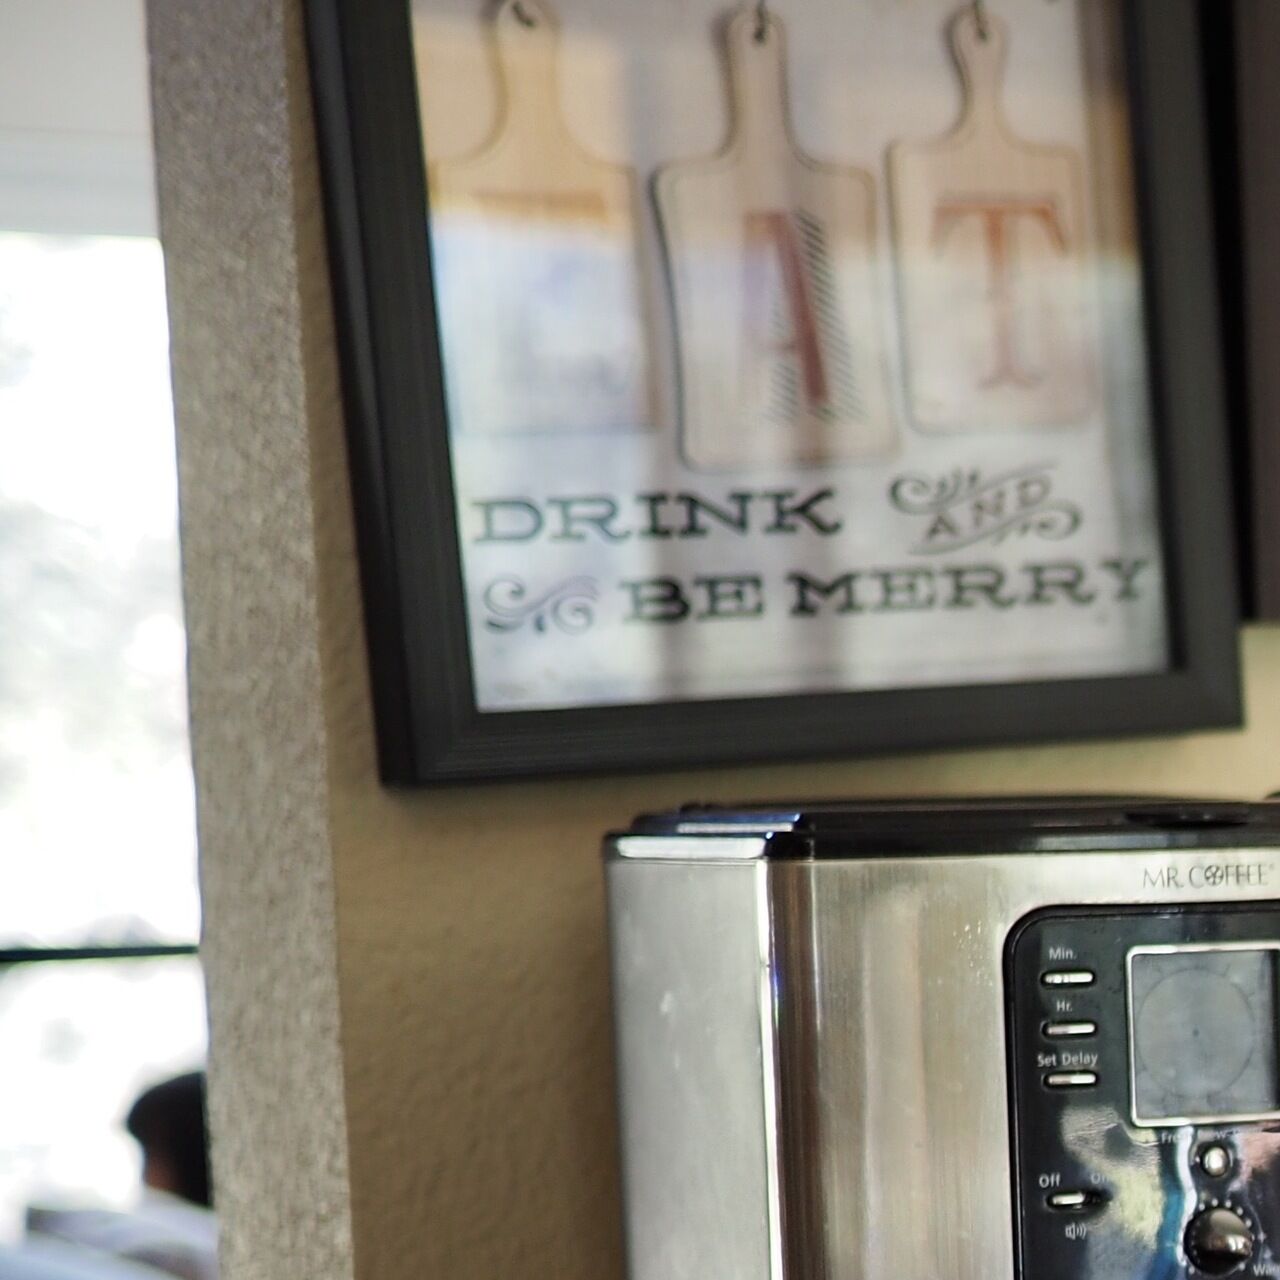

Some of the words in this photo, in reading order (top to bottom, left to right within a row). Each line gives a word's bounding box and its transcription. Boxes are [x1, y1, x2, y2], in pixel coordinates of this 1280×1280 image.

[472, 486, 842, 547] DRINK
[619, 573, 764, 624] BE
[786, 556, 1154, 618] MERRY
[1142, 865, 1185, 889] MR.
[1048, 946, 1077, 962] Min.
[1055, 999, 1073, 1013] Hr.
[1037, 1053, 1057, 1068] Set
[1061, 1051, 1098, 1068] Delay
[1038, 1173, 1061, 1188] Off
